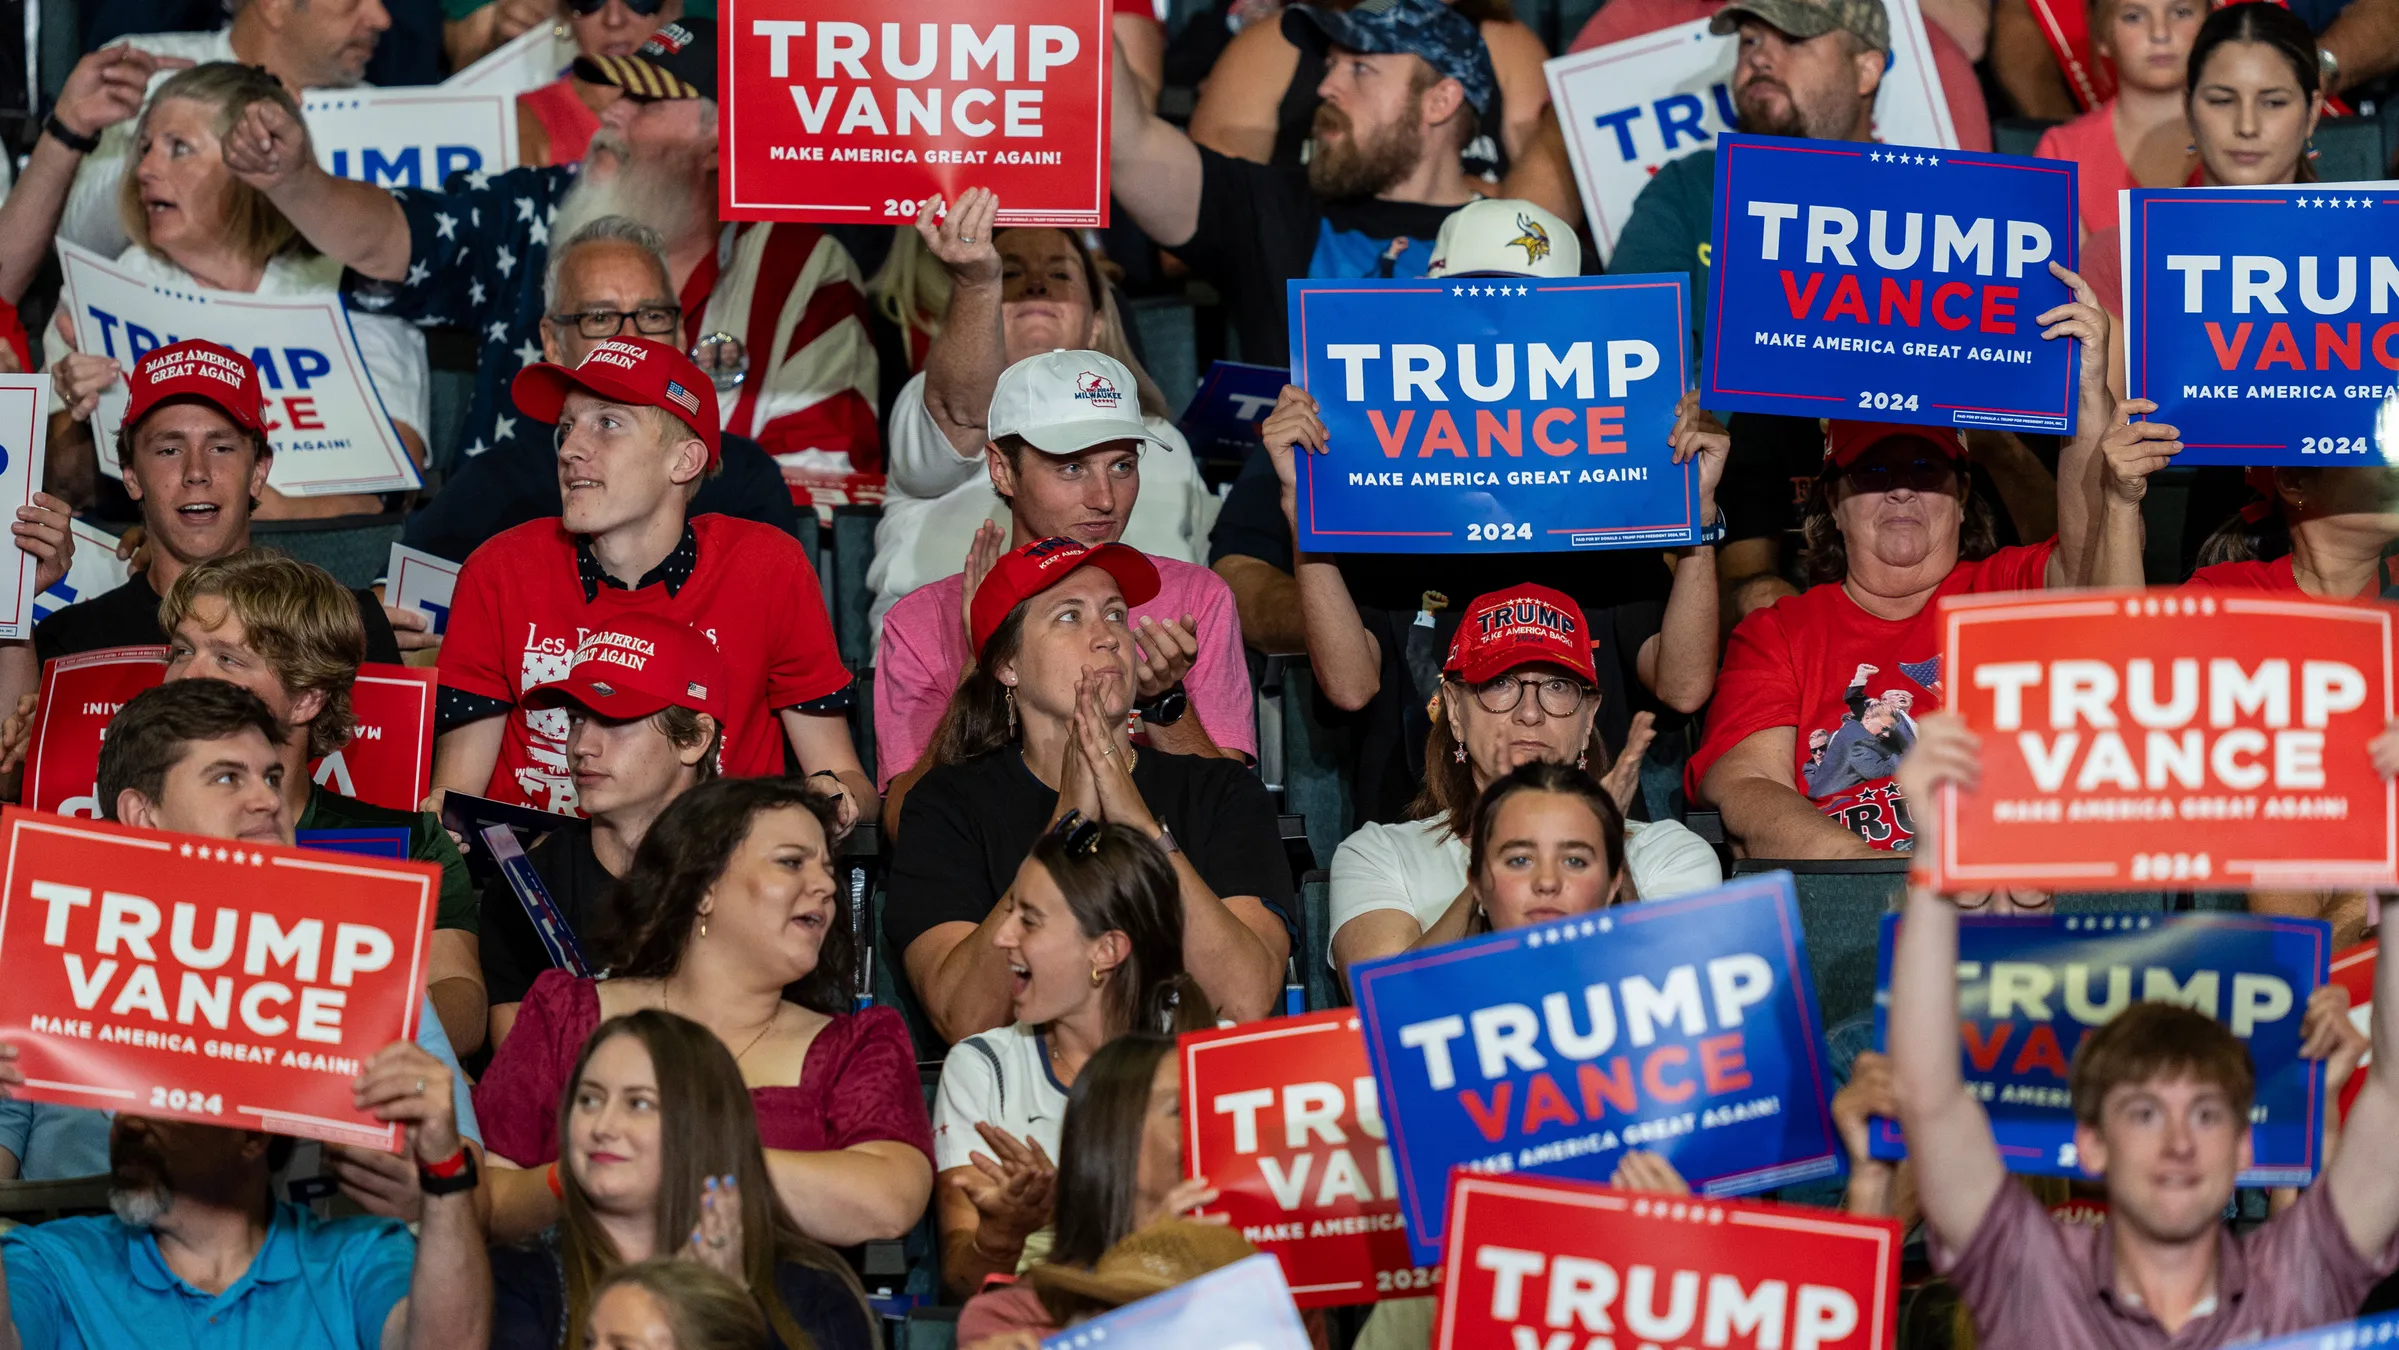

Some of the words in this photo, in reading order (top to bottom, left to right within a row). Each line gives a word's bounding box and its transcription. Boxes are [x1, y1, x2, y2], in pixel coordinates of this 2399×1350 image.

[753, 20, 1080, 82] TRUMP
[789, 85, 1043, 137] VANCE
[770, 146, 824, 161] MAKE
[830, 147, 917, 163] AMERICA
[924, 150, 987, 164] GREAT
[994, 151, 1062, 165] AGAIN!
[1748, 200, 2052, 278] TRUMP
[1779, 269, 2019, 335] VANCE
[591, 352, 637, 370] AGAIN
[1755, 331, 1807, 348] MAKE
[1812, 336, 1896, 354] AMERICA
[1902, 342, 1961, 359] GREAT
[1967, 346, 2032, 364] AGAIN!
[145, 351, 183, 374] MAKE
[185, 349, 246, 379] AMERICA
[151, 363, 195, 385] GREAT
[198, 364, 242, 389] AGAIN
[1327, 339, 1660, 402] TRUMP
[1074, 392, 1122, 400] MILWAUKEE
[1858, 391, 1919, 412] 2024
[2183, 385, 2239, 399] MAKE
[2246, 385, 2337, 399] AMERICA
[2344, 385, 2399, 399] GREA
[1366, 406, 1627, 459] VANCE
[2301, 437, 2368, 454] 2024
[1349, 472, 1403, 486] MAKE
[1411, 471, 1500, 486] AMERICA
[1507, 470, 1571, 485] GREAT
[1579, 467, 1648, 483] AGAIN!
[1467, 523, 1532, 541] 2024
[1039, 554, 1060, 569] KEEP
[1477, 602, 1575, 635] TRUMP
[524, 622, 566, 654] Les
[593, 631, 655, 656] AMERICA
[1481, 630, 1502, 644] TAKE
[1505, 626, 1547, 637] AMERICA
[1549, 631, 1573, 648] BACK!
[1515, 634, 1543, 643] 2024
[597, 648, 647, 672] AGAIN
[1973, 658, 2367, 731] TRUMP
[2018, 729, 2327, 792] VANCE
[30, 880, 395, 987] TRUMP
[63, 953, 347, 1045] VANCE
[1400, 952, 1774, 1091] TRUMP
[31, 1015, 91, 1039] MAKE
[99, 1024, 196, 1055] AMERICA
[204, 1039, 276, 1066] GREAT
[281, 1050, 359, 1077] AGAIN!
[149, 1086, 223, 1116] 2024
[1457, 1032, 1752, 1143] VANCE
[1519, 1131, 1618, 1169] AMERICA
[1622, 1113, 1696, 1146] GREAT
[1702, 1096, 1780, 1131] AGAIN!
[1243, 1221, 1304, 1243] MAKE
[1310, 1212, 1408, 1239] AMERICA
[1476, 1245, 1859, 1350] TRUMP
